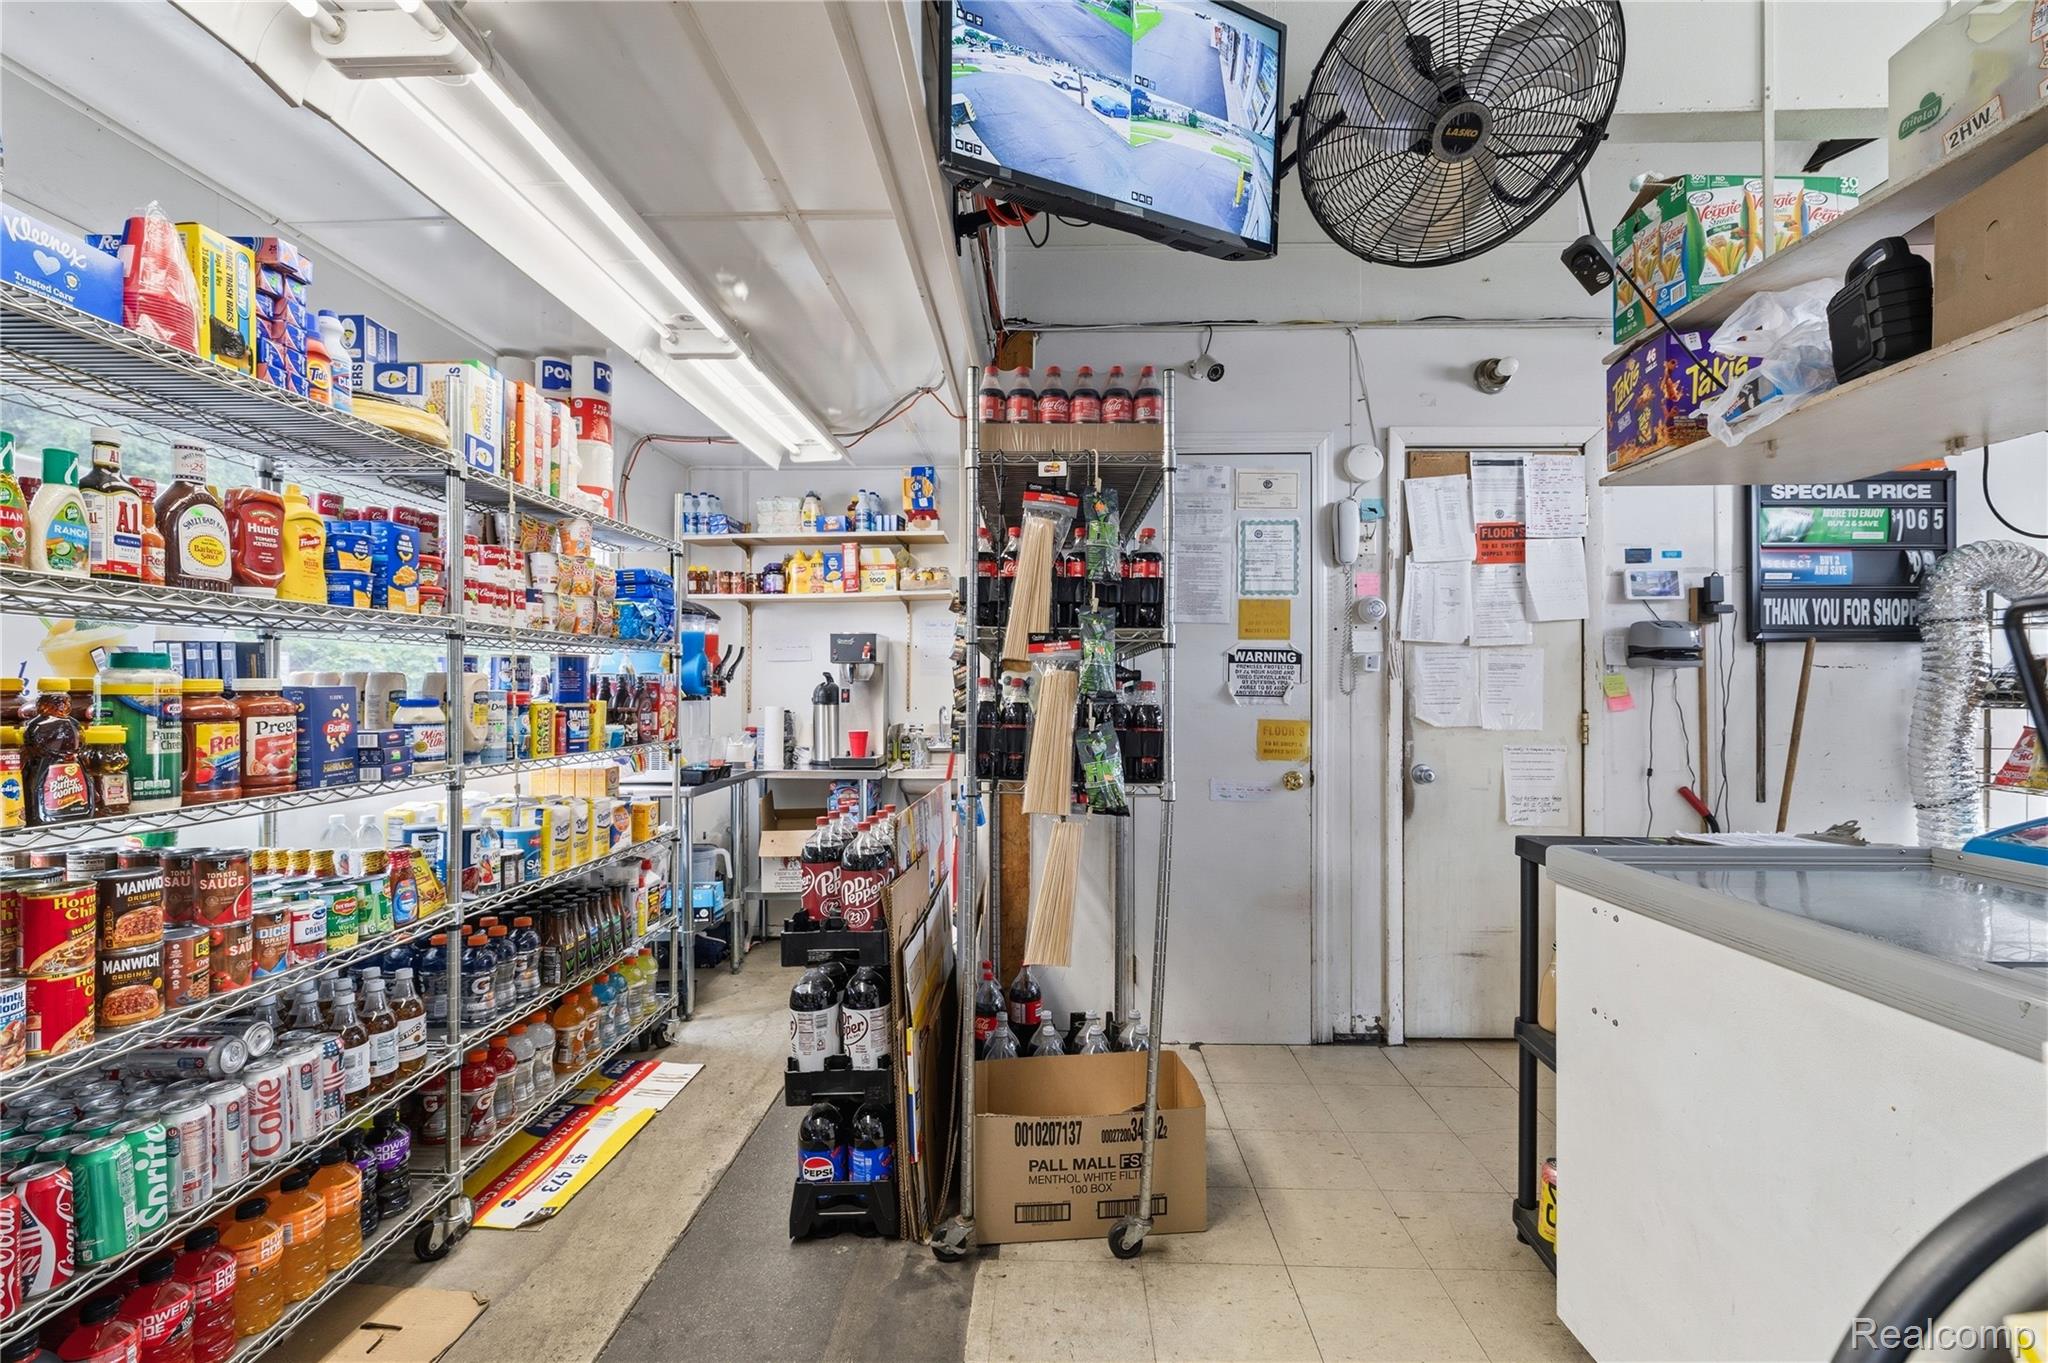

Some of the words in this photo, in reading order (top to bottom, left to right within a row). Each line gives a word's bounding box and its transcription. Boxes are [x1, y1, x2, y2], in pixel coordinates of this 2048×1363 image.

[1445, 127, 1479, 138] LASKO
[1949, 107, 1991, 149] 2HW
[1840, 177, 1859, 188] 30
[1752, 193, 1798, 210] Vegie
[1696, 202, 1742, 222] Veggie
[4, 215, 88, 269] Kleenex
[14, 270, 53, 294] Trusted
[53, 287, 76, 302] Care
[225, 270, 235, 295] TRASH
[226, 296, 235, 323] BAGS
[309, 367, 328, 381] Tide
[1686, 356, 1750, 404] Takis
[1612, 363, 1640, 406] Takis
[485, 380, 496, 441] CRACKERS
[1771, 484, 1860, 499] SPECIAL
[1867, 484, 1932, 499] PRICE
[54, 524, 88, 539] RANCH
[1481, 527, 1526, 539] FLOOR'S
[1830, 565, 1848, 575] SAVE
[1763, 598, 1810, 625] THANK
[1811, 598, 1840, 625] YOU
[1843, 598, 1870, 625] FOR
[1873, 598, 1919, 625] SHOPP
[1234, 651, 1297, 663] WARNING
[206, 871, 238, 879] TOMATO
[200, 877, 244, 890] SAUCE
[855, 876, 874, 892] Dr
[842, 881, 884, 906] Pepper
[103, 953, 160, 975] MANWICH
[112, 971, 151, 981] ORIGINAL
[0, 991, 23, 1004] inty
[0, 1000, 25, 1012] oore
[251, 1077, 283, 1158] Coke
[324, 1110, 338, 1122] USA
[543, 1104, 575, 1129] POM
[571, 1111, 589, 1130] Over
[1015, 1121, 1082, 1147] 0010207137
[511, 1147, 543, 1179] Sheets
[571, 1153, 588, 1166] 45
[1029, 1159, 1068, 1172] PALL
[1072, 1156, 1116, 1171] MALL
[135, 1121, 168, 1228] Sprite
[803, 1169, 833, 1177] PEPSI
[1028, 1174, 1080, 1185] MENTHOL
[1083, 1172, 1117, 1183] WHITE
[1119, 1170, 1142, 1181] FILT
[541, 1171, 573, 1193] 473
[1070, 1185, 1088, 1194] 100
[1090, 1183, 1113, 1193] BOX
